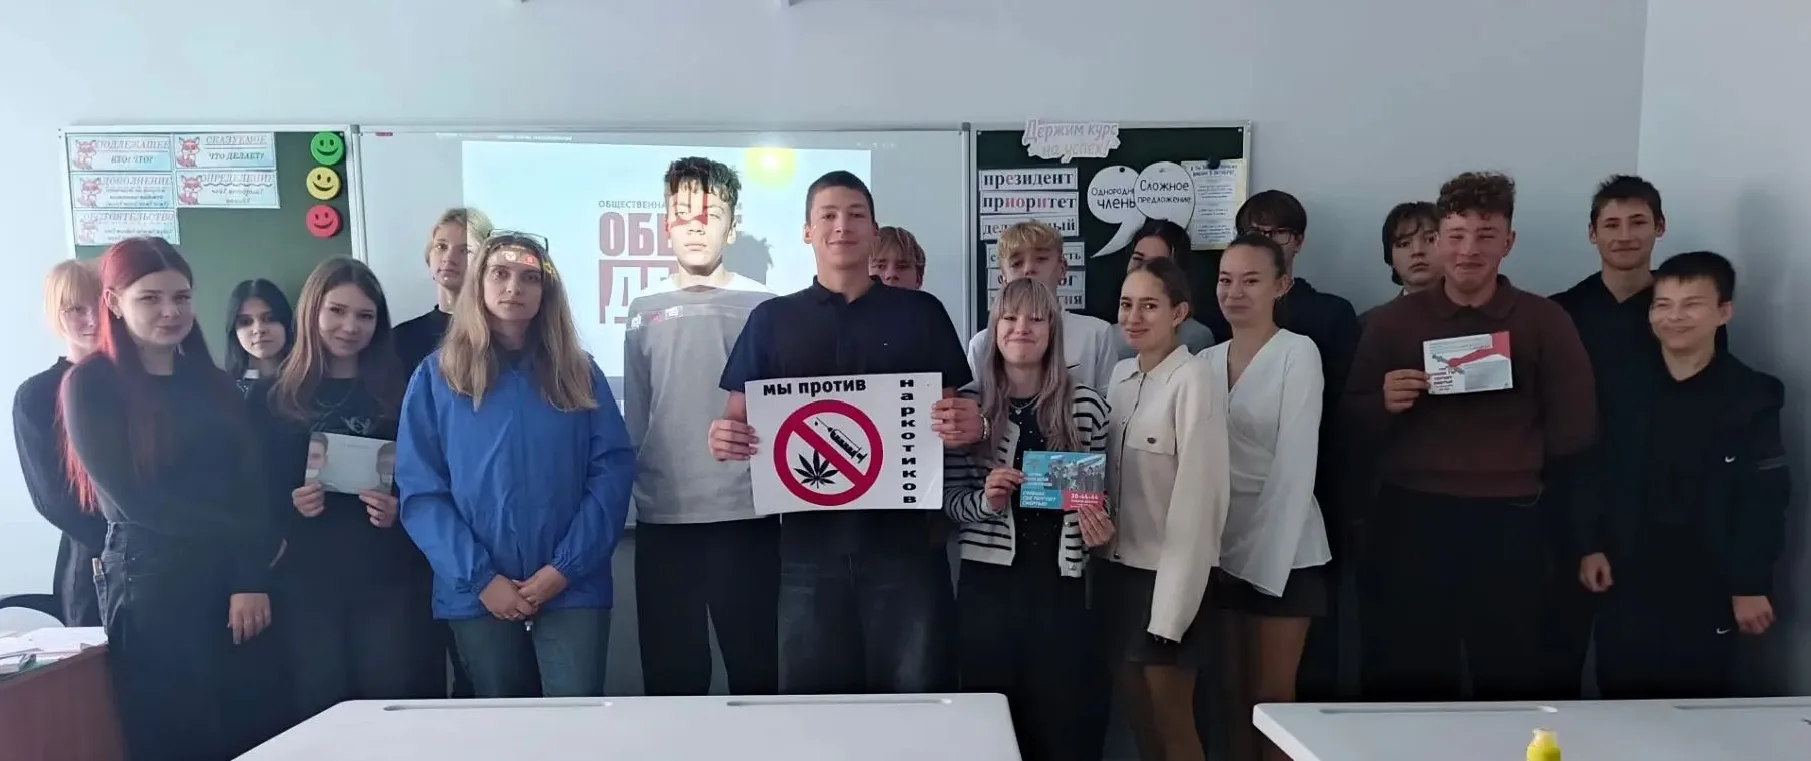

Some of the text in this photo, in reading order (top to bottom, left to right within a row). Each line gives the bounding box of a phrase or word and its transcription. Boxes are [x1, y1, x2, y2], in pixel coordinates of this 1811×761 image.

[1023, 119, 1118, 144] Держим курс
[111, 155, 154, 164] КТО? ЧТО?
[226, 152, 265, 160] ДЕЛАЕТ?
[983, 173, 1074, 189] президент
[1140, 180, 1190, 191] Сложное
[1091, 187, 1135, 196] Однородн
[598, 200, 667, 210] ОБЩЕСТВЕННА
[983, 196, 1077, 212] приоритет
[1137, 196, 1192, 204] предложение
[763, 379, 867, 398] мы против
[899, 379, 917, 504] наркотиков
